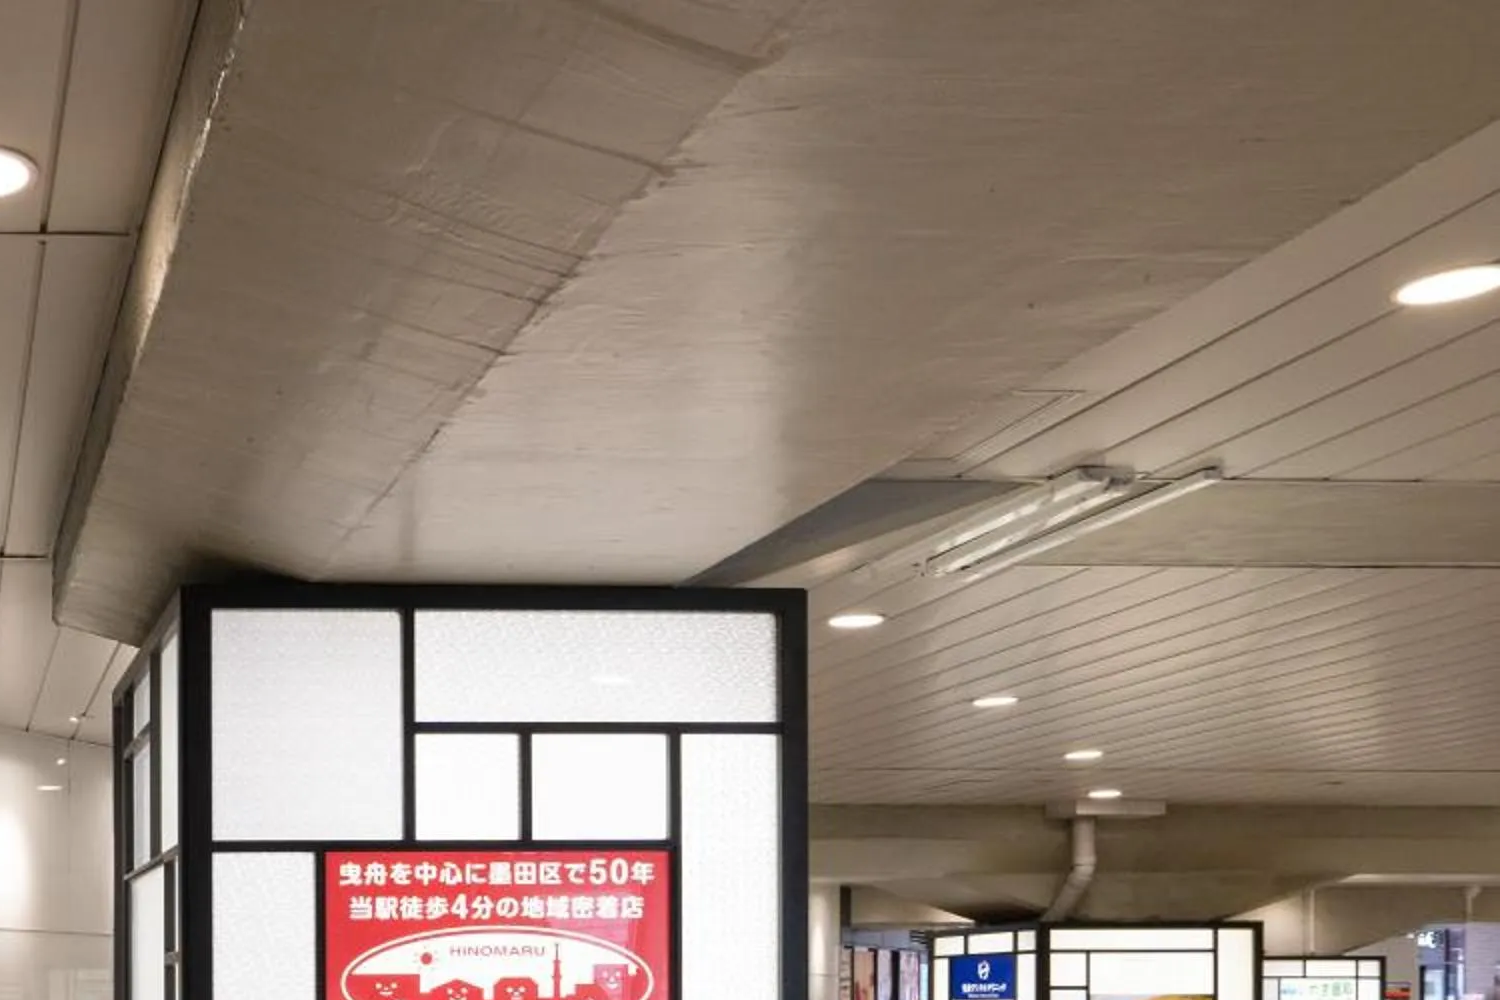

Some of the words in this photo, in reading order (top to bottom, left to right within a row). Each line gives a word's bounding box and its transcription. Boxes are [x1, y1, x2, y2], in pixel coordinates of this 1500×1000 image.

[339, 857, 655, 886] 曳舟を中心に墨田区で50年
[349, 894, 645, 919] 当駅徒歩4分の地域密着店
[449, 945, 546, 957] HINOMARU
